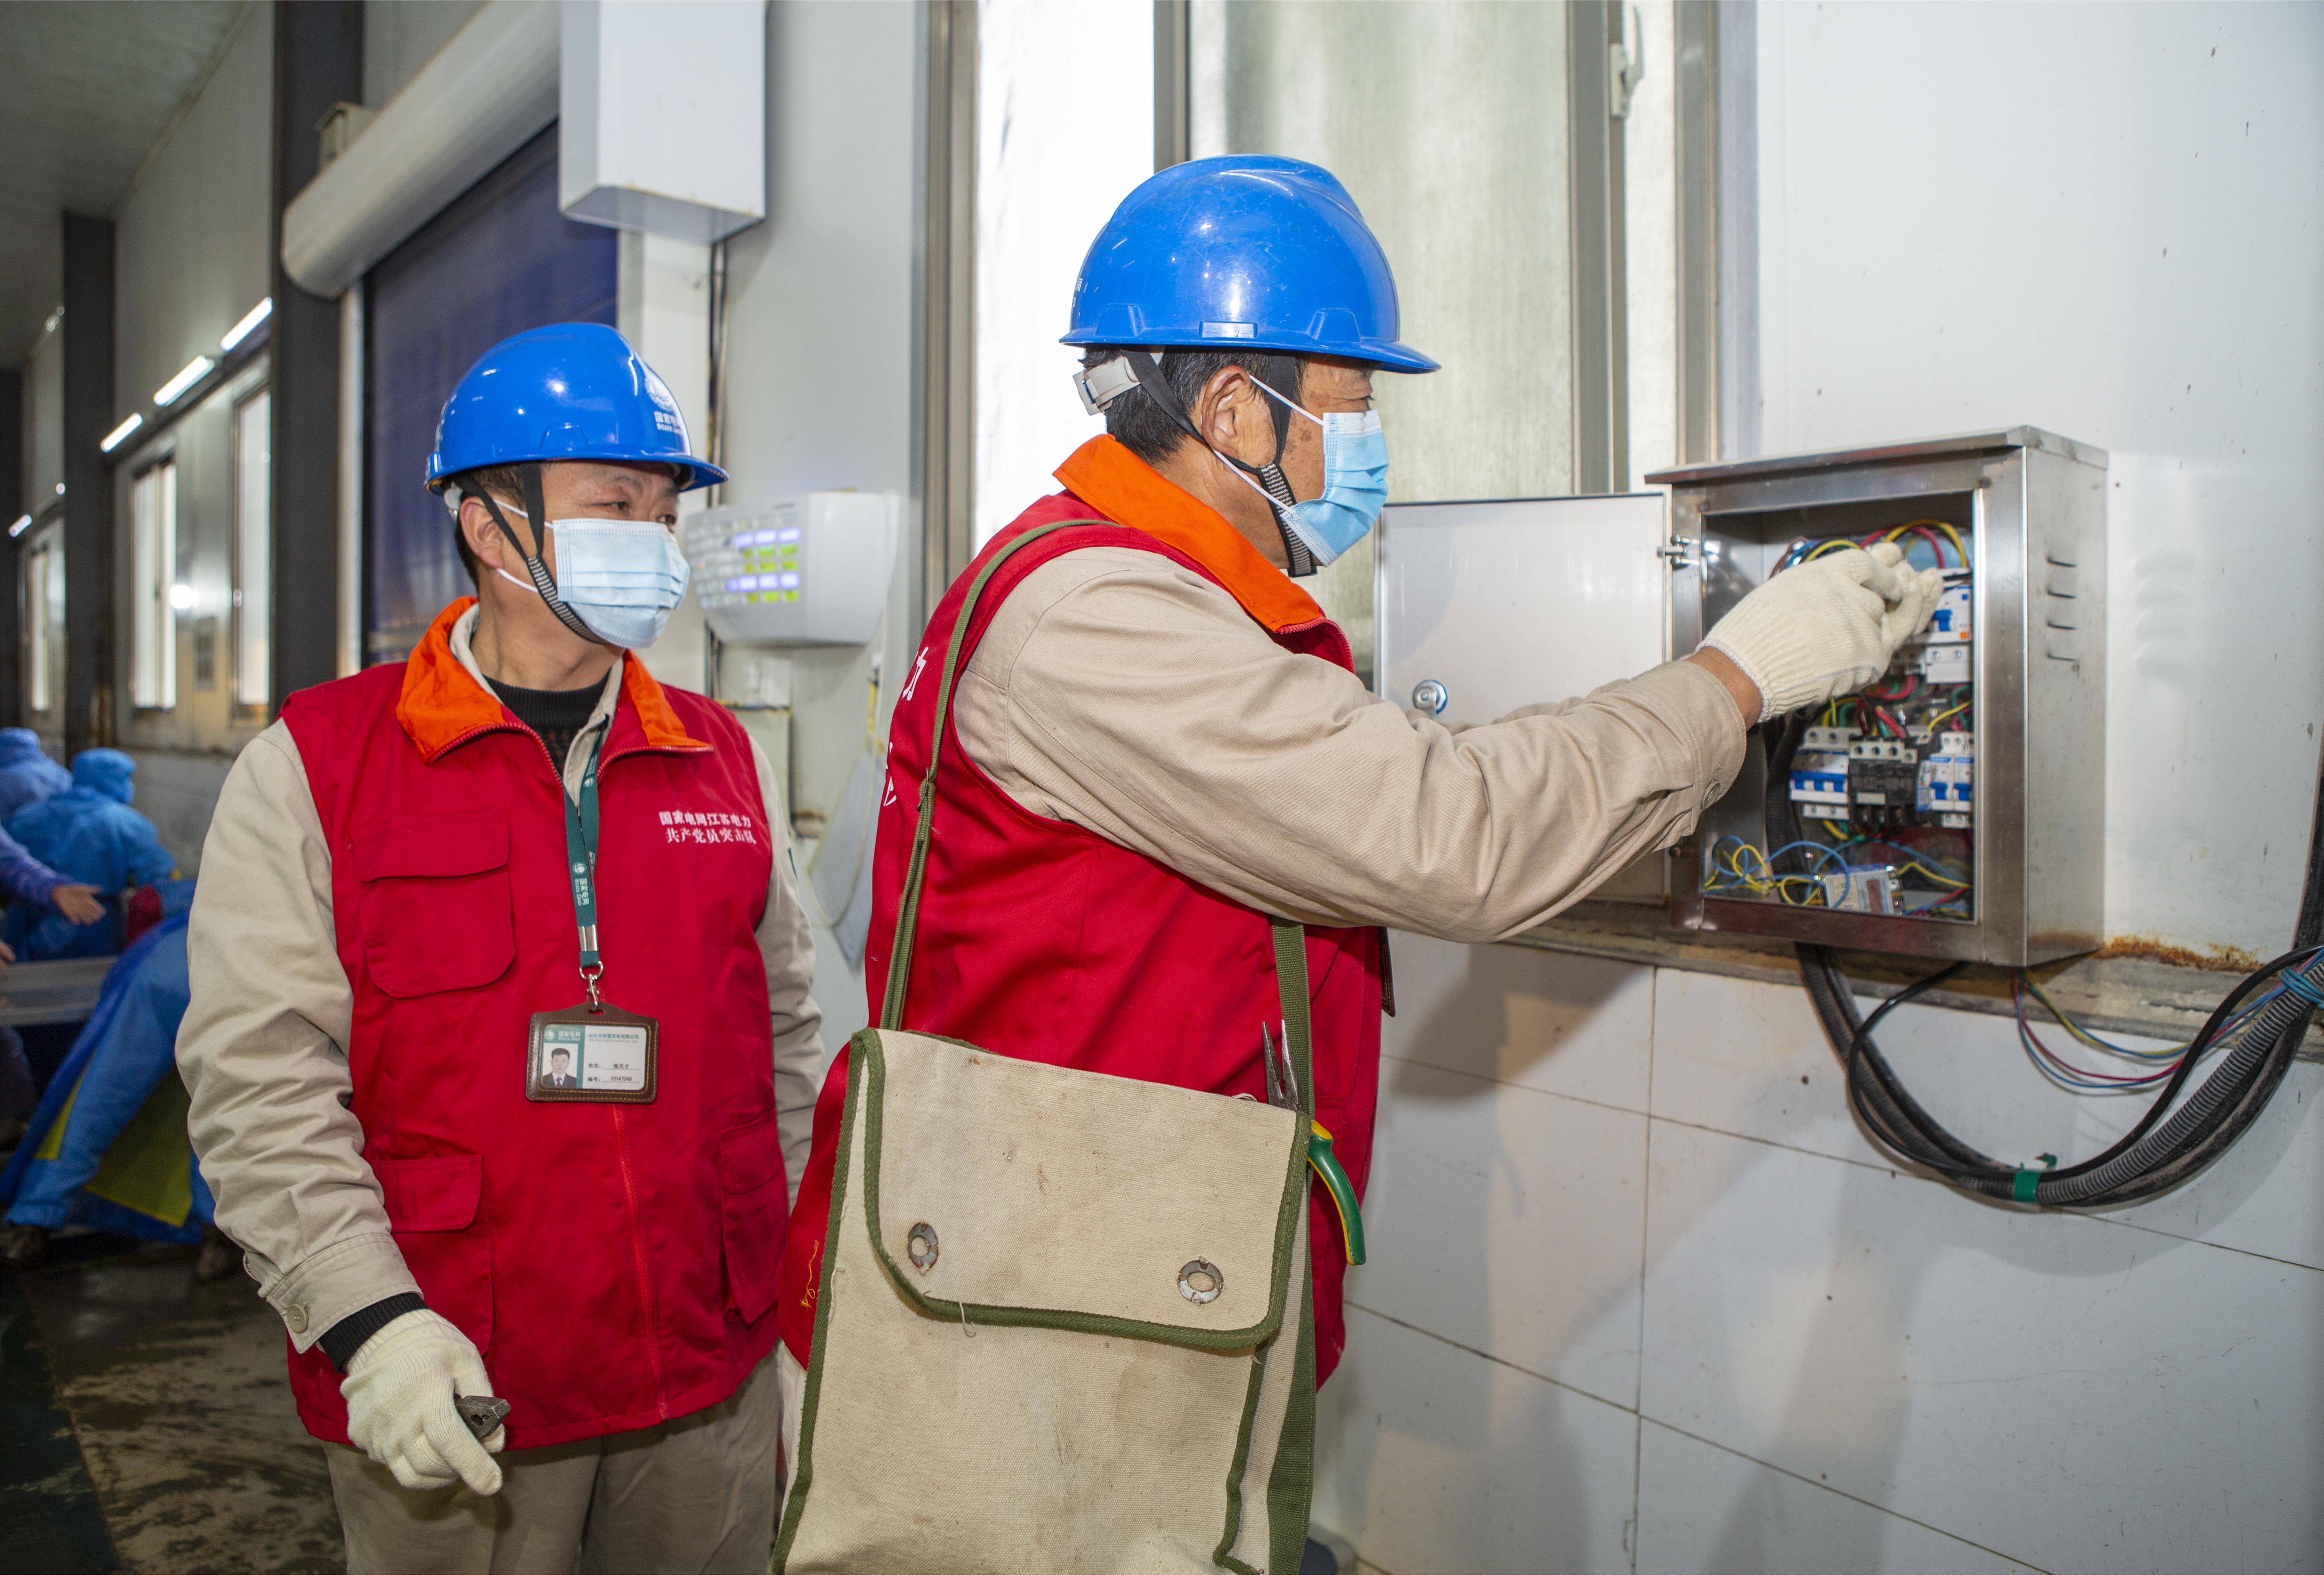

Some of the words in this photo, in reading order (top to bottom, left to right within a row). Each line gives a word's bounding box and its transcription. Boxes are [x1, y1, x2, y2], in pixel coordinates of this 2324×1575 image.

[659, 810, 751, 828] 国家电网江苏电力
[665, 827, 757, 844] 共产党员突击队
